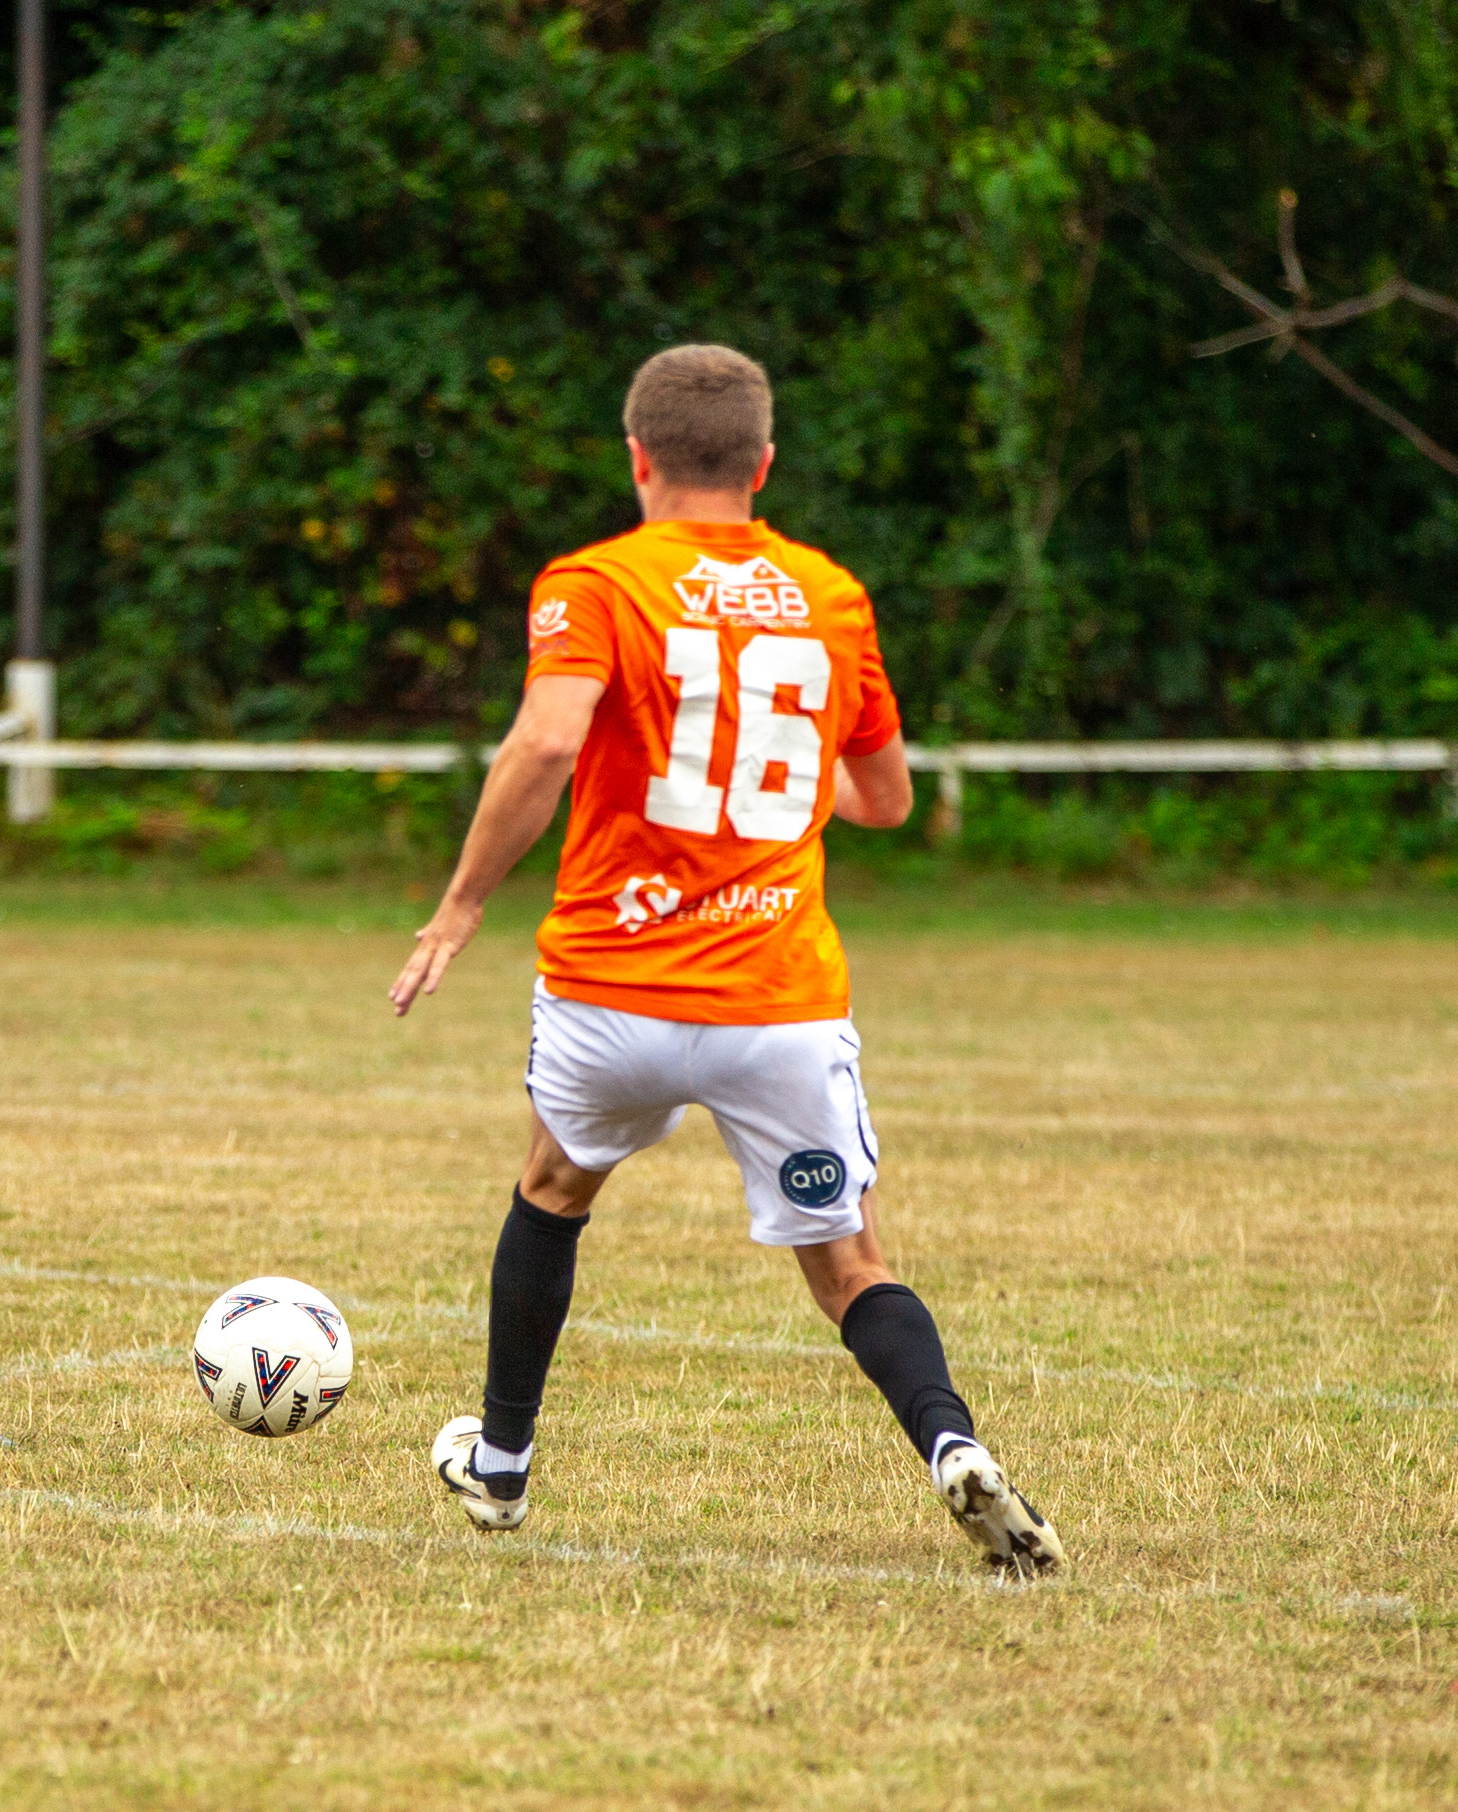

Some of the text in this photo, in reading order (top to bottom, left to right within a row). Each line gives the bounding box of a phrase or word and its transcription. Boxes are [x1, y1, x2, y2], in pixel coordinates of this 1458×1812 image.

[672, 581, 810, 618] WEBB
[645, 627, 831, 842] 16
[688, 884, 800, 911] UART
[790, 1164, 836, 1189] Q10
